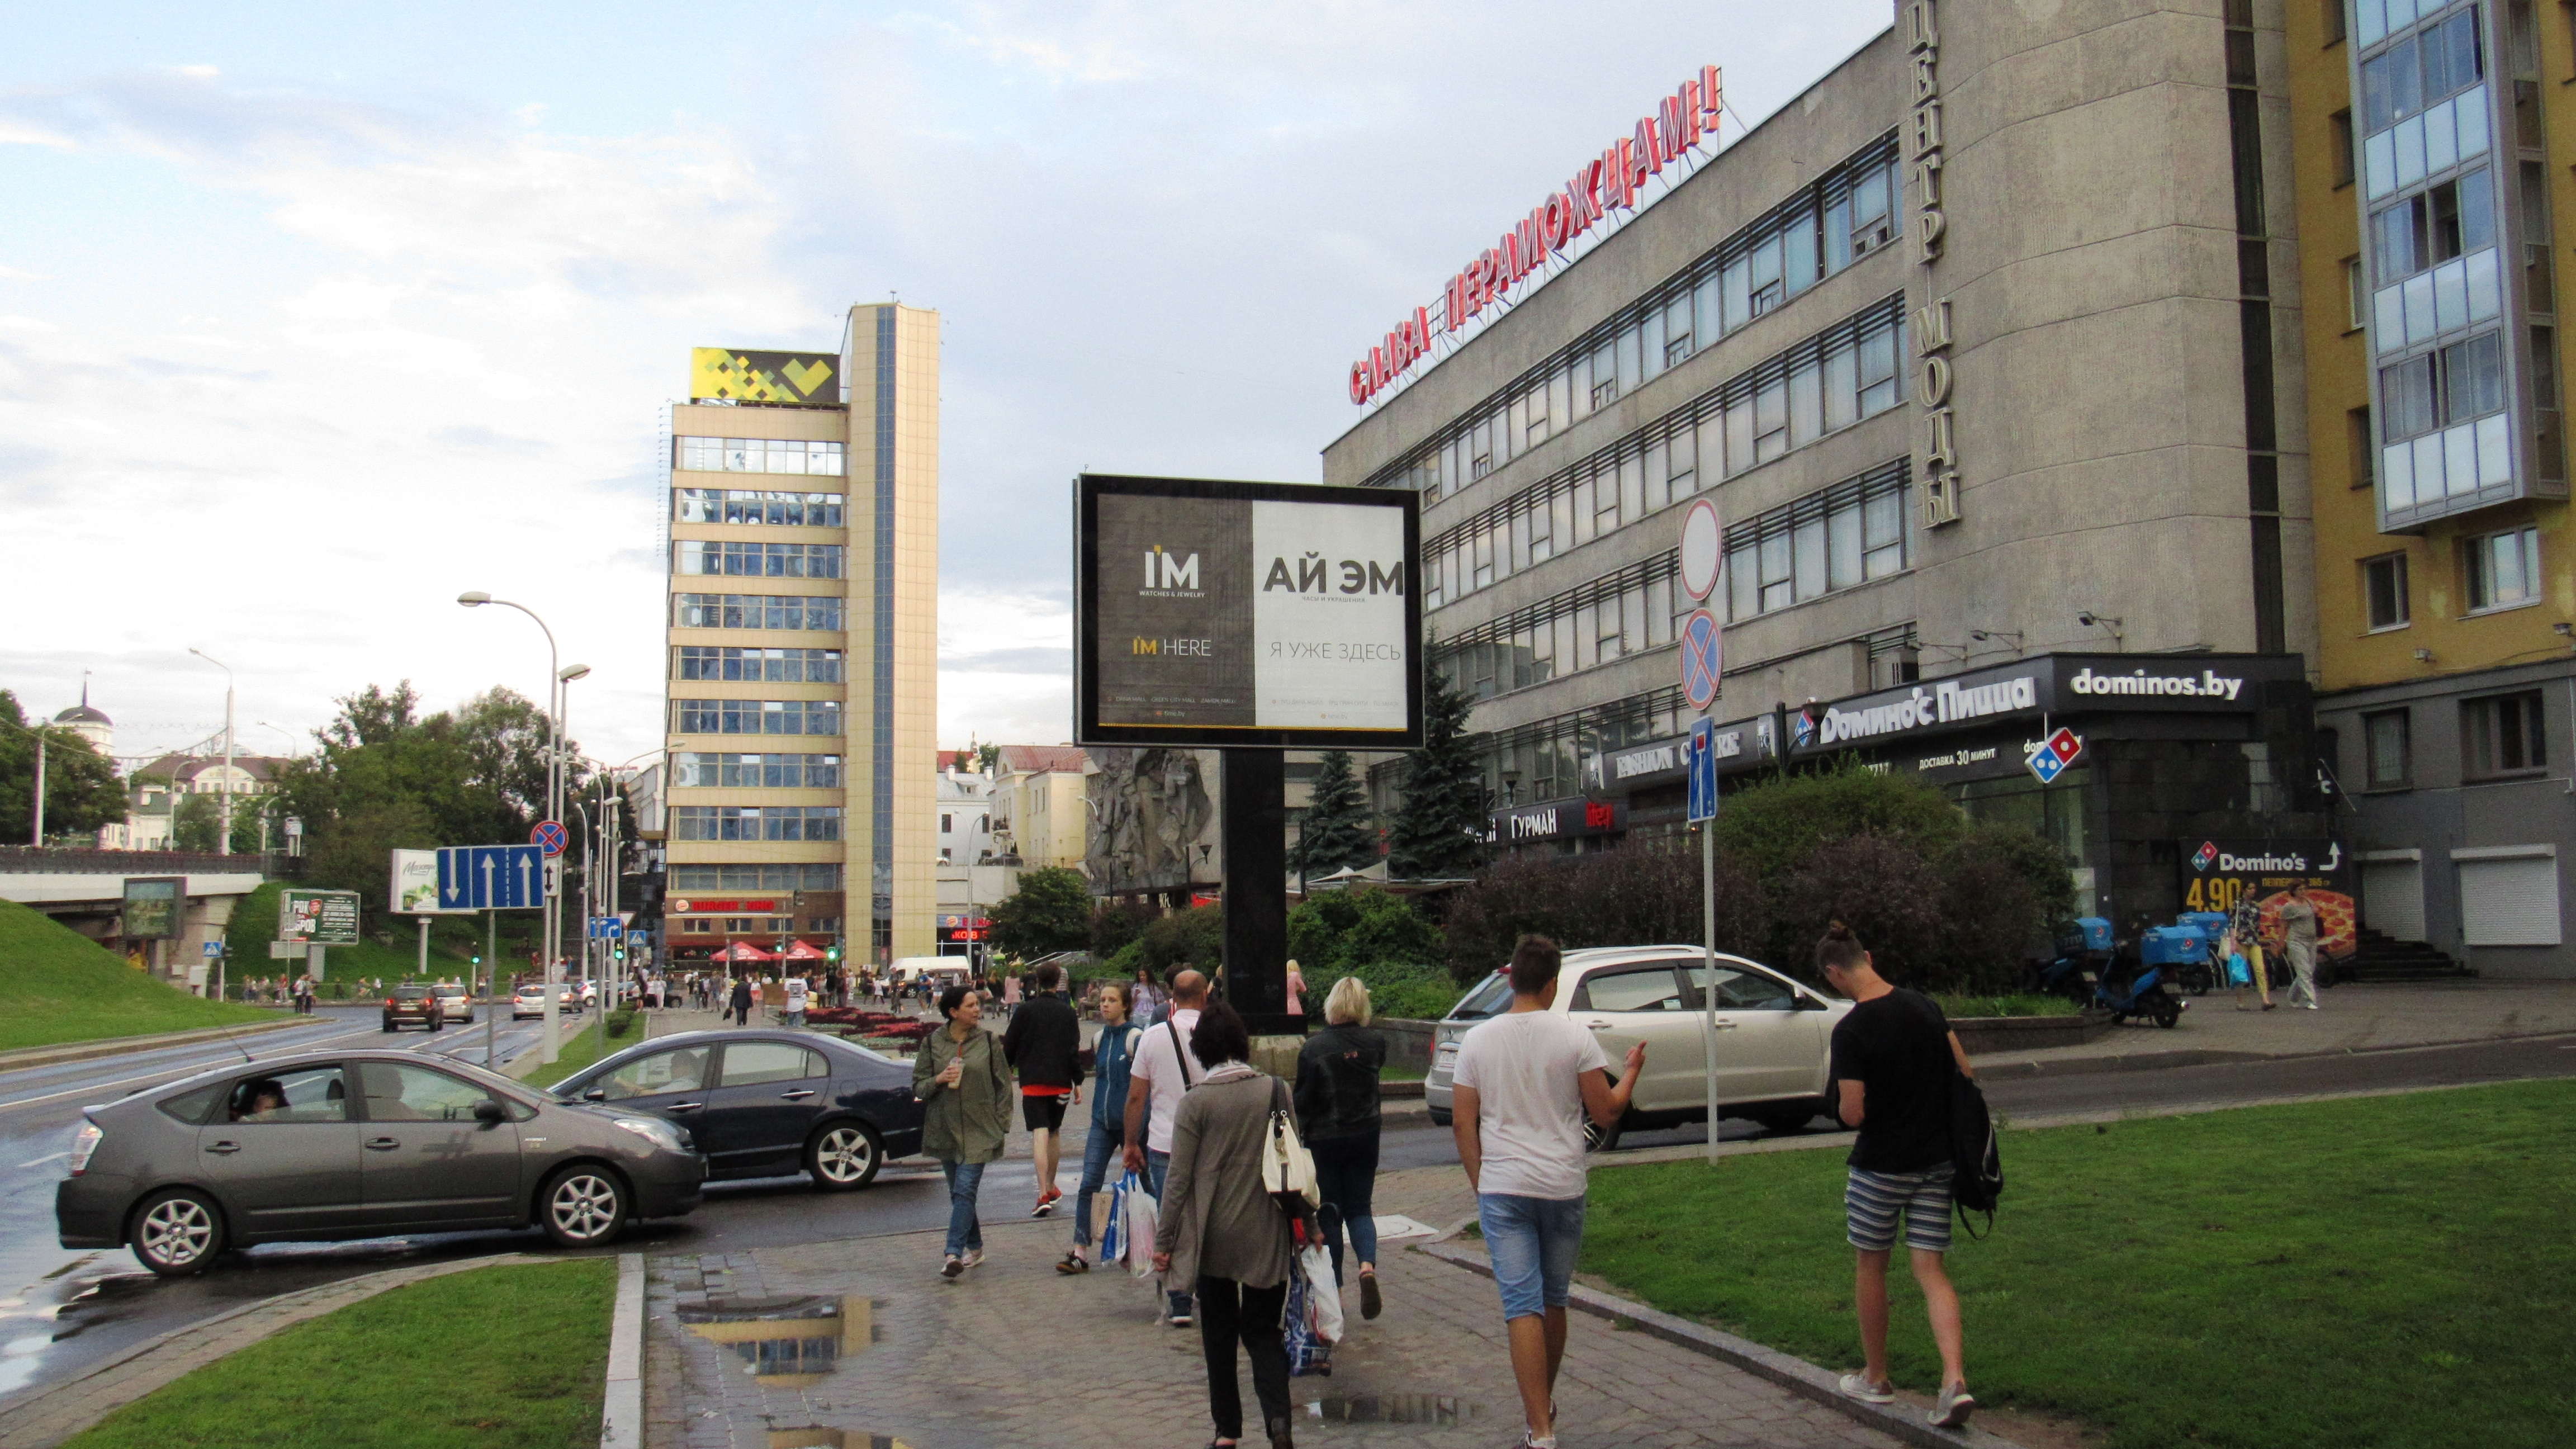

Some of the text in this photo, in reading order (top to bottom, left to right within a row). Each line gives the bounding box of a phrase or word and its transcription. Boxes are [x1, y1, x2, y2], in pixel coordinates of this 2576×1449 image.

[1349, 65, 1720, 405] СЛАВА ПЕРАМОЖЦАМ!
[1916, 296, 1961, 531] МОДЫ
[1262, 550, 1404, 596] АЙ ЭМ
[1164, 638, 1212, 657] HERE
[1270, 641, 1401, 663] Я УЖЕ ЗДЕСЬ
[2070, 668, 2242, 700] dominos.by
[1616, 746, 1673, 779] FASHION
[1919, 748, 1996, 771] ДОСТАВКА 30 МИНУТ
[1511, 808, 1557, 838] ГУРМАН
[2219, 853, 2306, 872] Domino's
[692, 901, 739, 911] BURGER
